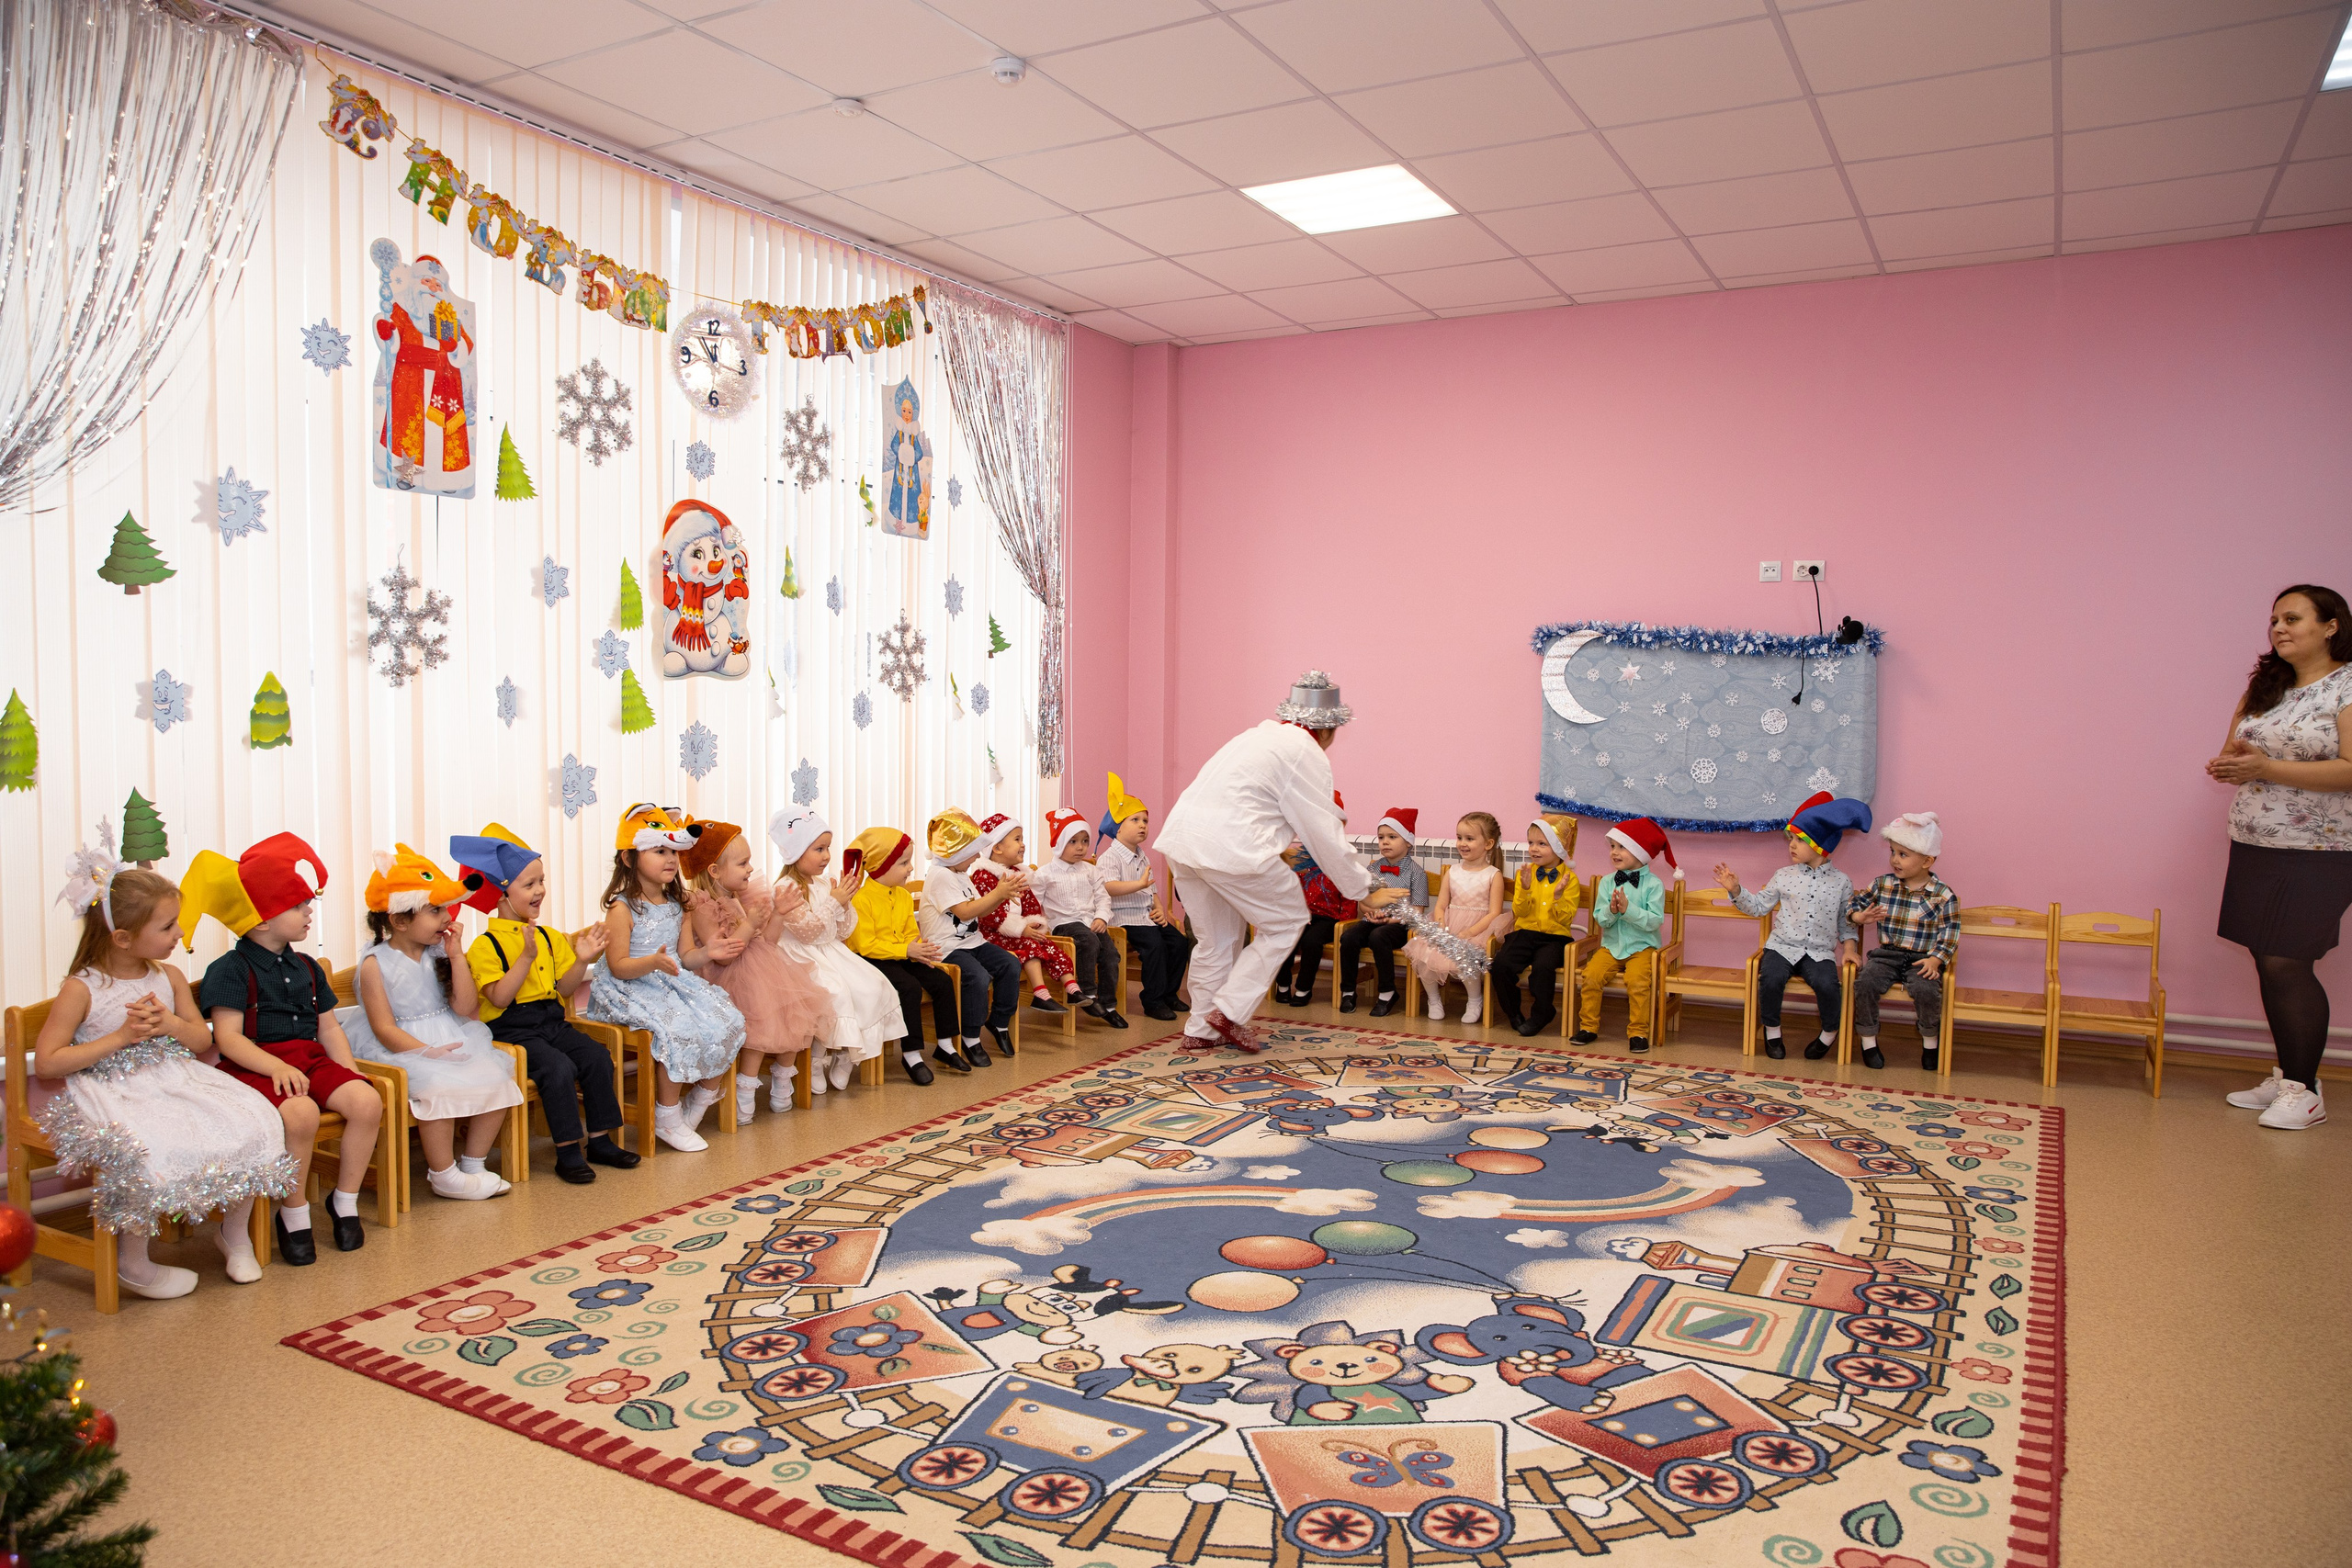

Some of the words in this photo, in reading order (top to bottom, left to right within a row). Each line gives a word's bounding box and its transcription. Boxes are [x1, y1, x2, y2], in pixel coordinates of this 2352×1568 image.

[319, 85, 391, 160] С
[398, 141, 672, 333] НОВЫМ
[707, 320, 721, 336] 12
[681, 346, 691, 364] 9
[739, 359, 747, 376] 3
[708, 390, 718, 408] 6
